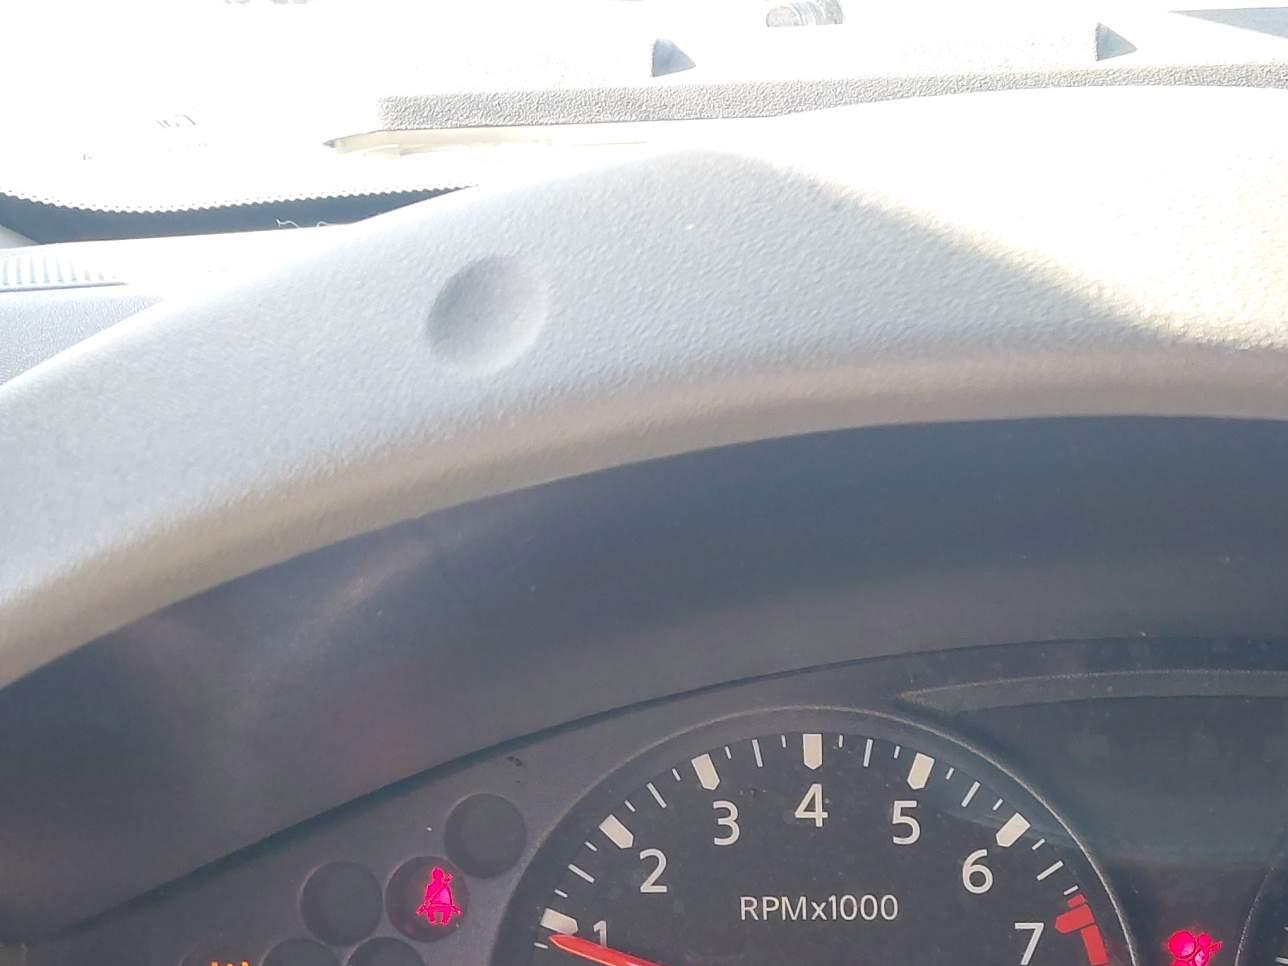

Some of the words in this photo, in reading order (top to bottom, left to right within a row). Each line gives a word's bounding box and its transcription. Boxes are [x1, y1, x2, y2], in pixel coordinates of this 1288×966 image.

[712, 800, 740, 846] 3
[794, 783, 829, 828] 4
[892, 800, 921, 845] 5
[639, 848, 668, 893] 2
[962, 848, 993, 894] 6
[740, 894, 898, 921] RPMx1000
[1014, 922, 1045, 966] 7
